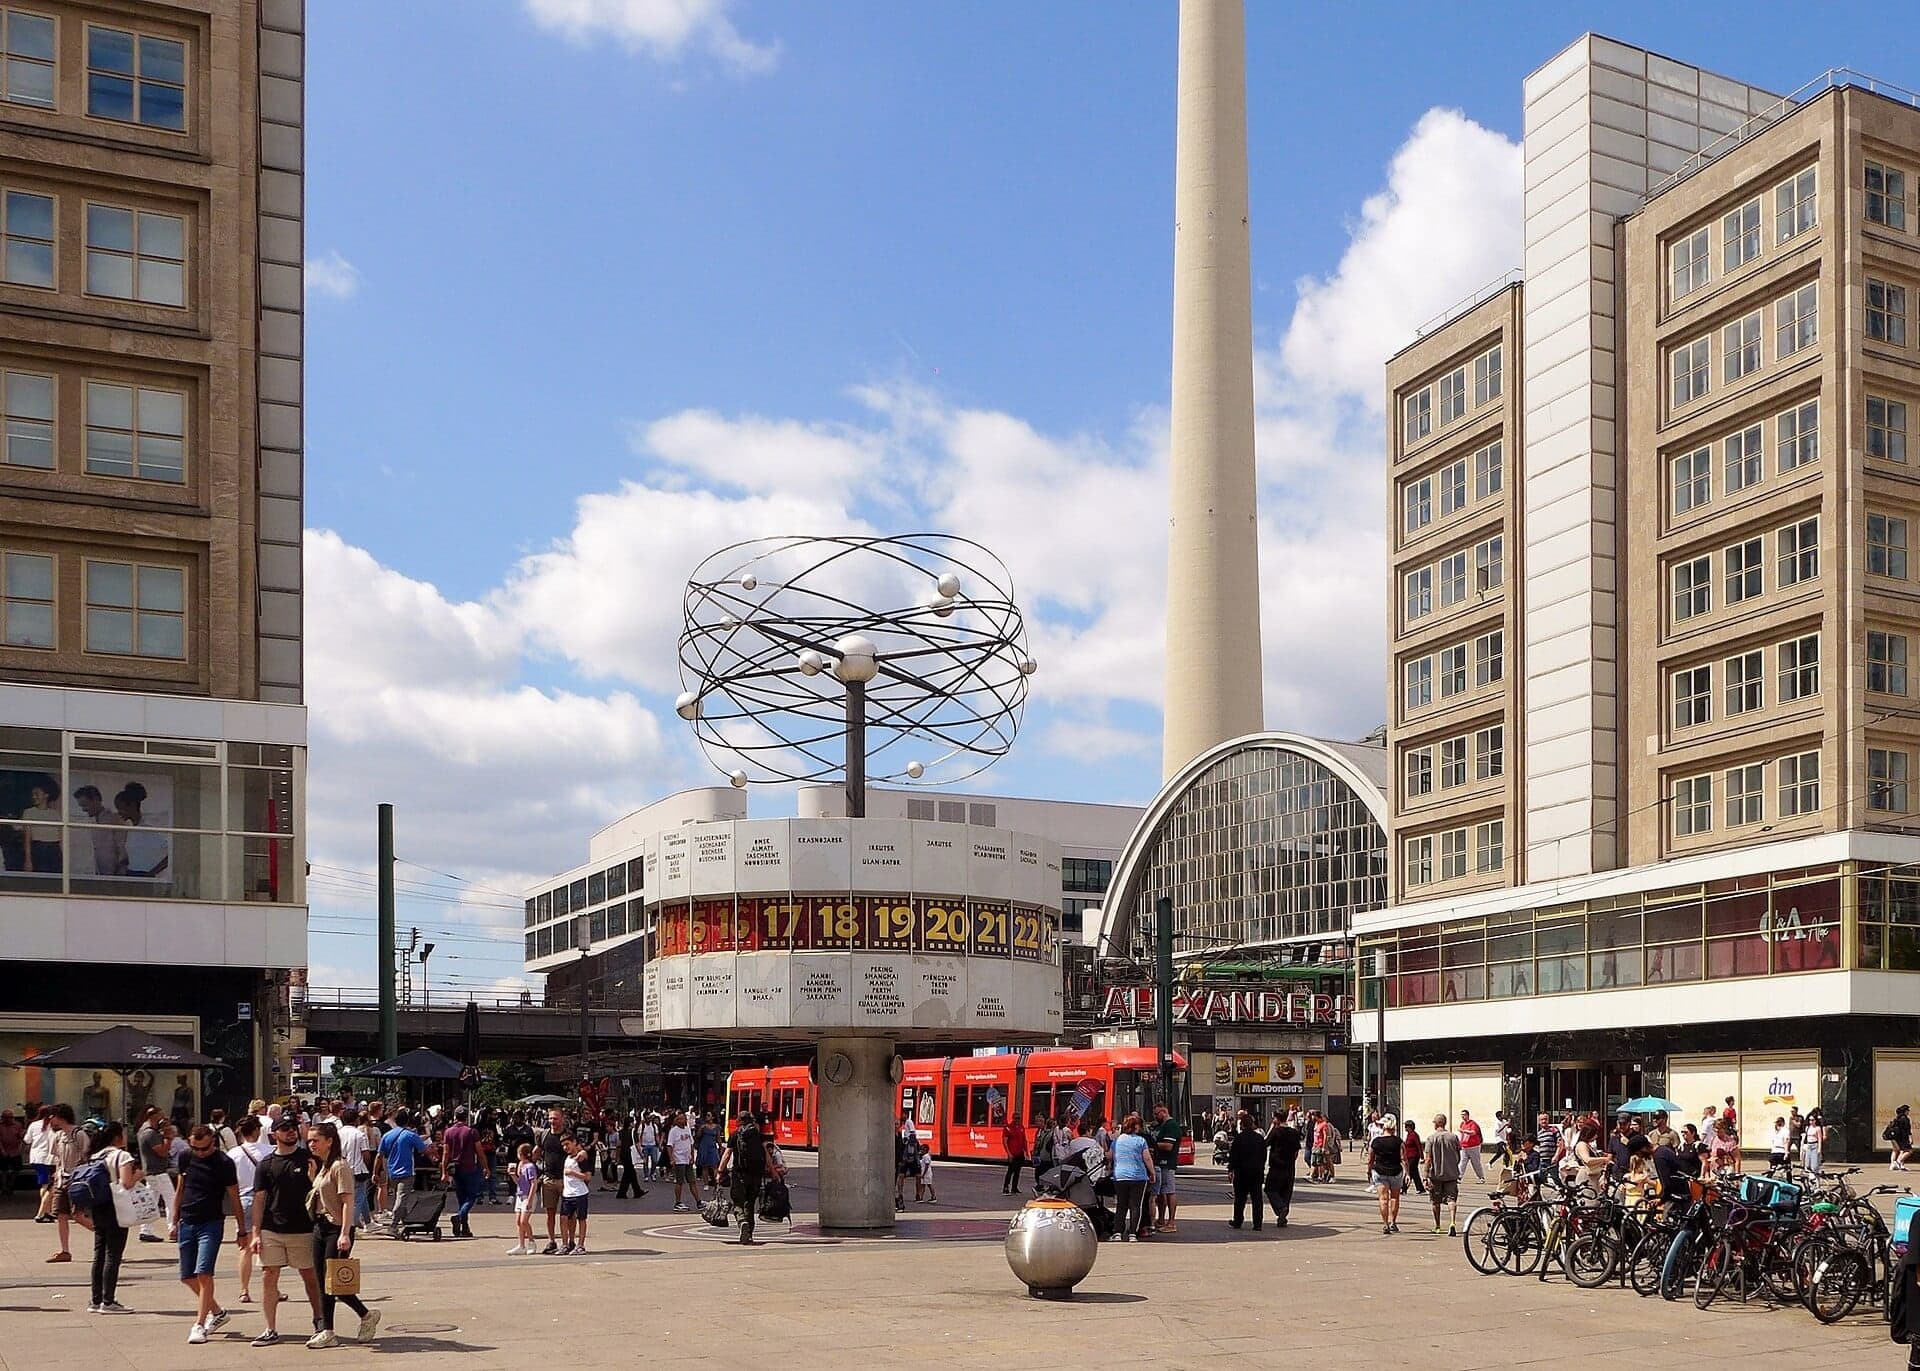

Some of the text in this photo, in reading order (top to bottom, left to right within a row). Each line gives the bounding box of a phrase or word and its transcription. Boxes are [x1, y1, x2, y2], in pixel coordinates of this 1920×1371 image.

[717, 906, 750, 939] 16
[763, 905, 803, 937] 17
[818, 905, 859, 938] 18
[874, 906, 916, 939] 19
[926, 907, 970, 942] 20
[977, 911, 1007, 944] 21
[1014, 915, 1039, 948] 22
[1759, 907, 1807, 942] C&A
[1104, 986, 1355, 1024] ALXANDERP
[1251, 1084, 1303, 1093] McDonald's
[1768, 1076, 1792, 1095] dm
